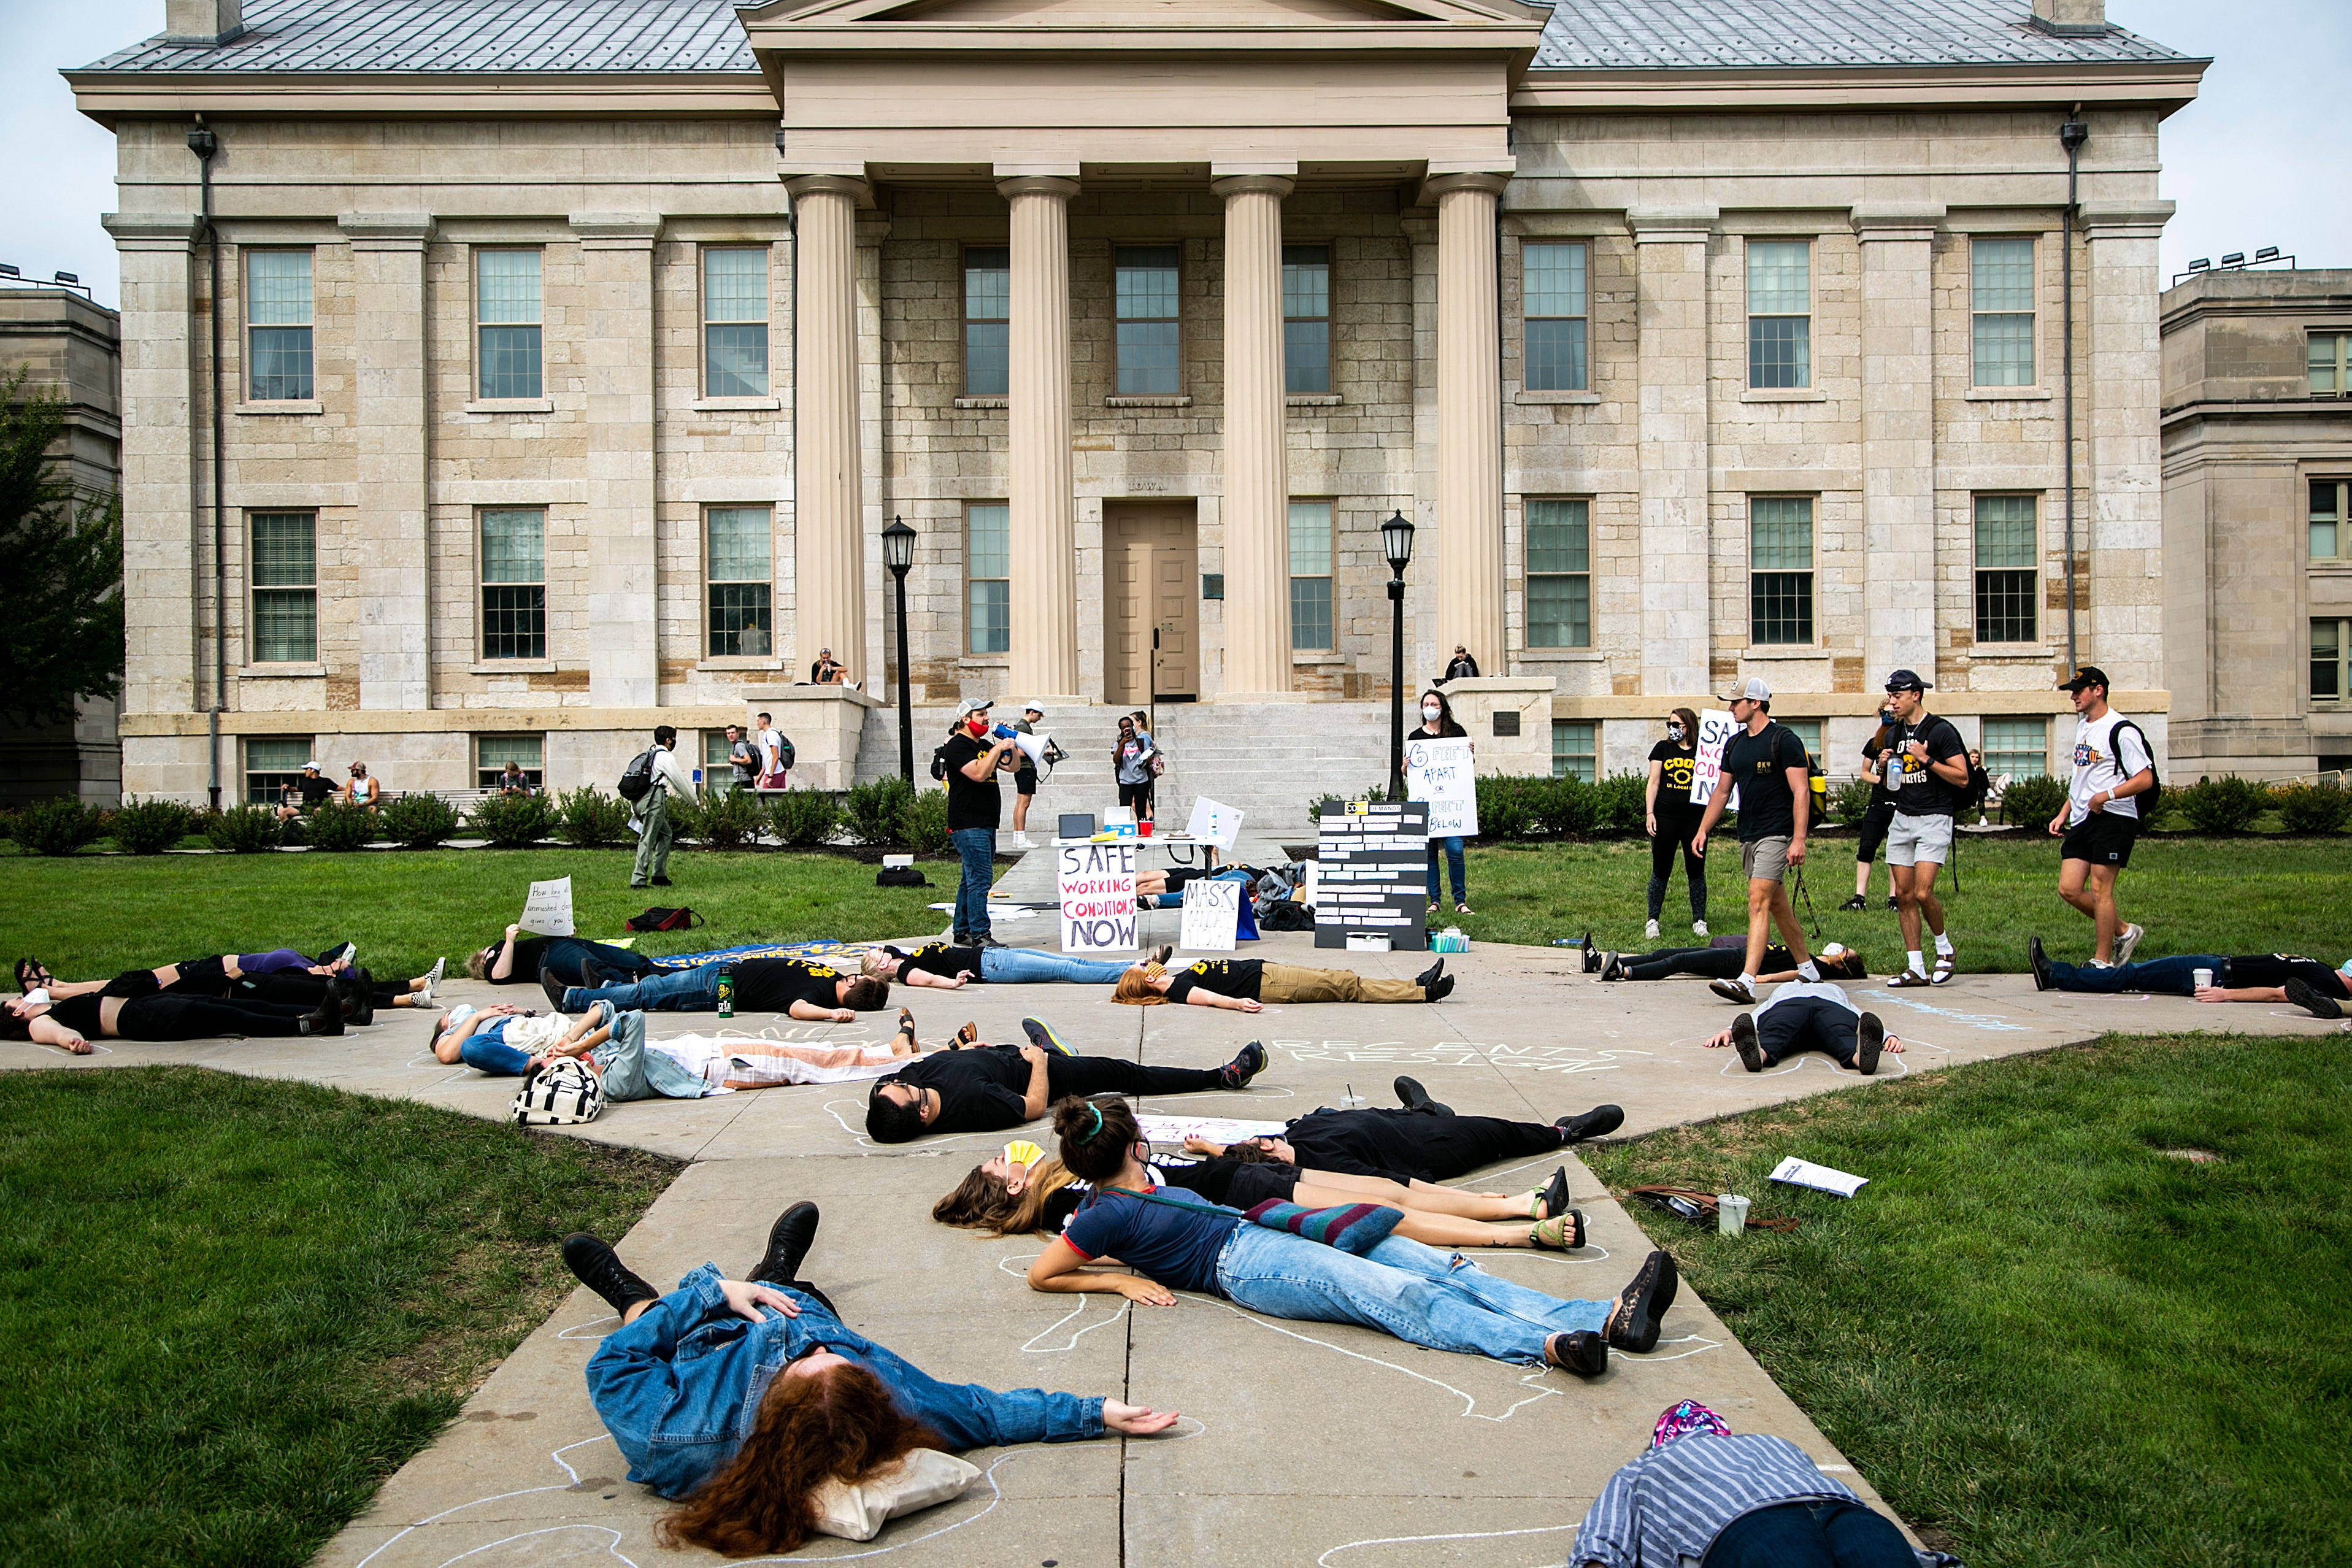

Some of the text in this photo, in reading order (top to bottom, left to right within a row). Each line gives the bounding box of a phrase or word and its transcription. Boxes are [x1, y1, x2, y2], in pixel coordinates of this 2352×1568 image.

[1701, 720, 1748, 745] SA
[1409, 743, 1470, 768] 6 FEET
[1663, 757, 1695, 771] COG
[1423, 766, 1456, 785] APART
[1902, 769, 1927, 784] WKEYES
[1431, 799, 1464, 814] FEET
[1429, 817, 1462, 832] BELOW
[1064, 845, 1135, 875] SAFE
[532, 885, 547, 897] How
[1062, 878, 1131, 894] WORKING
[1185, 883, 1236, 910] MASK
[528, 902, 557, 912] unmasked
[1063, 898, 1136, 920] CONDITIONS
[553, 918, 564, 926] you
[1070, 915, 1137, 947] NOW
[1288, 1049, 1621, 1074] RESIGN
